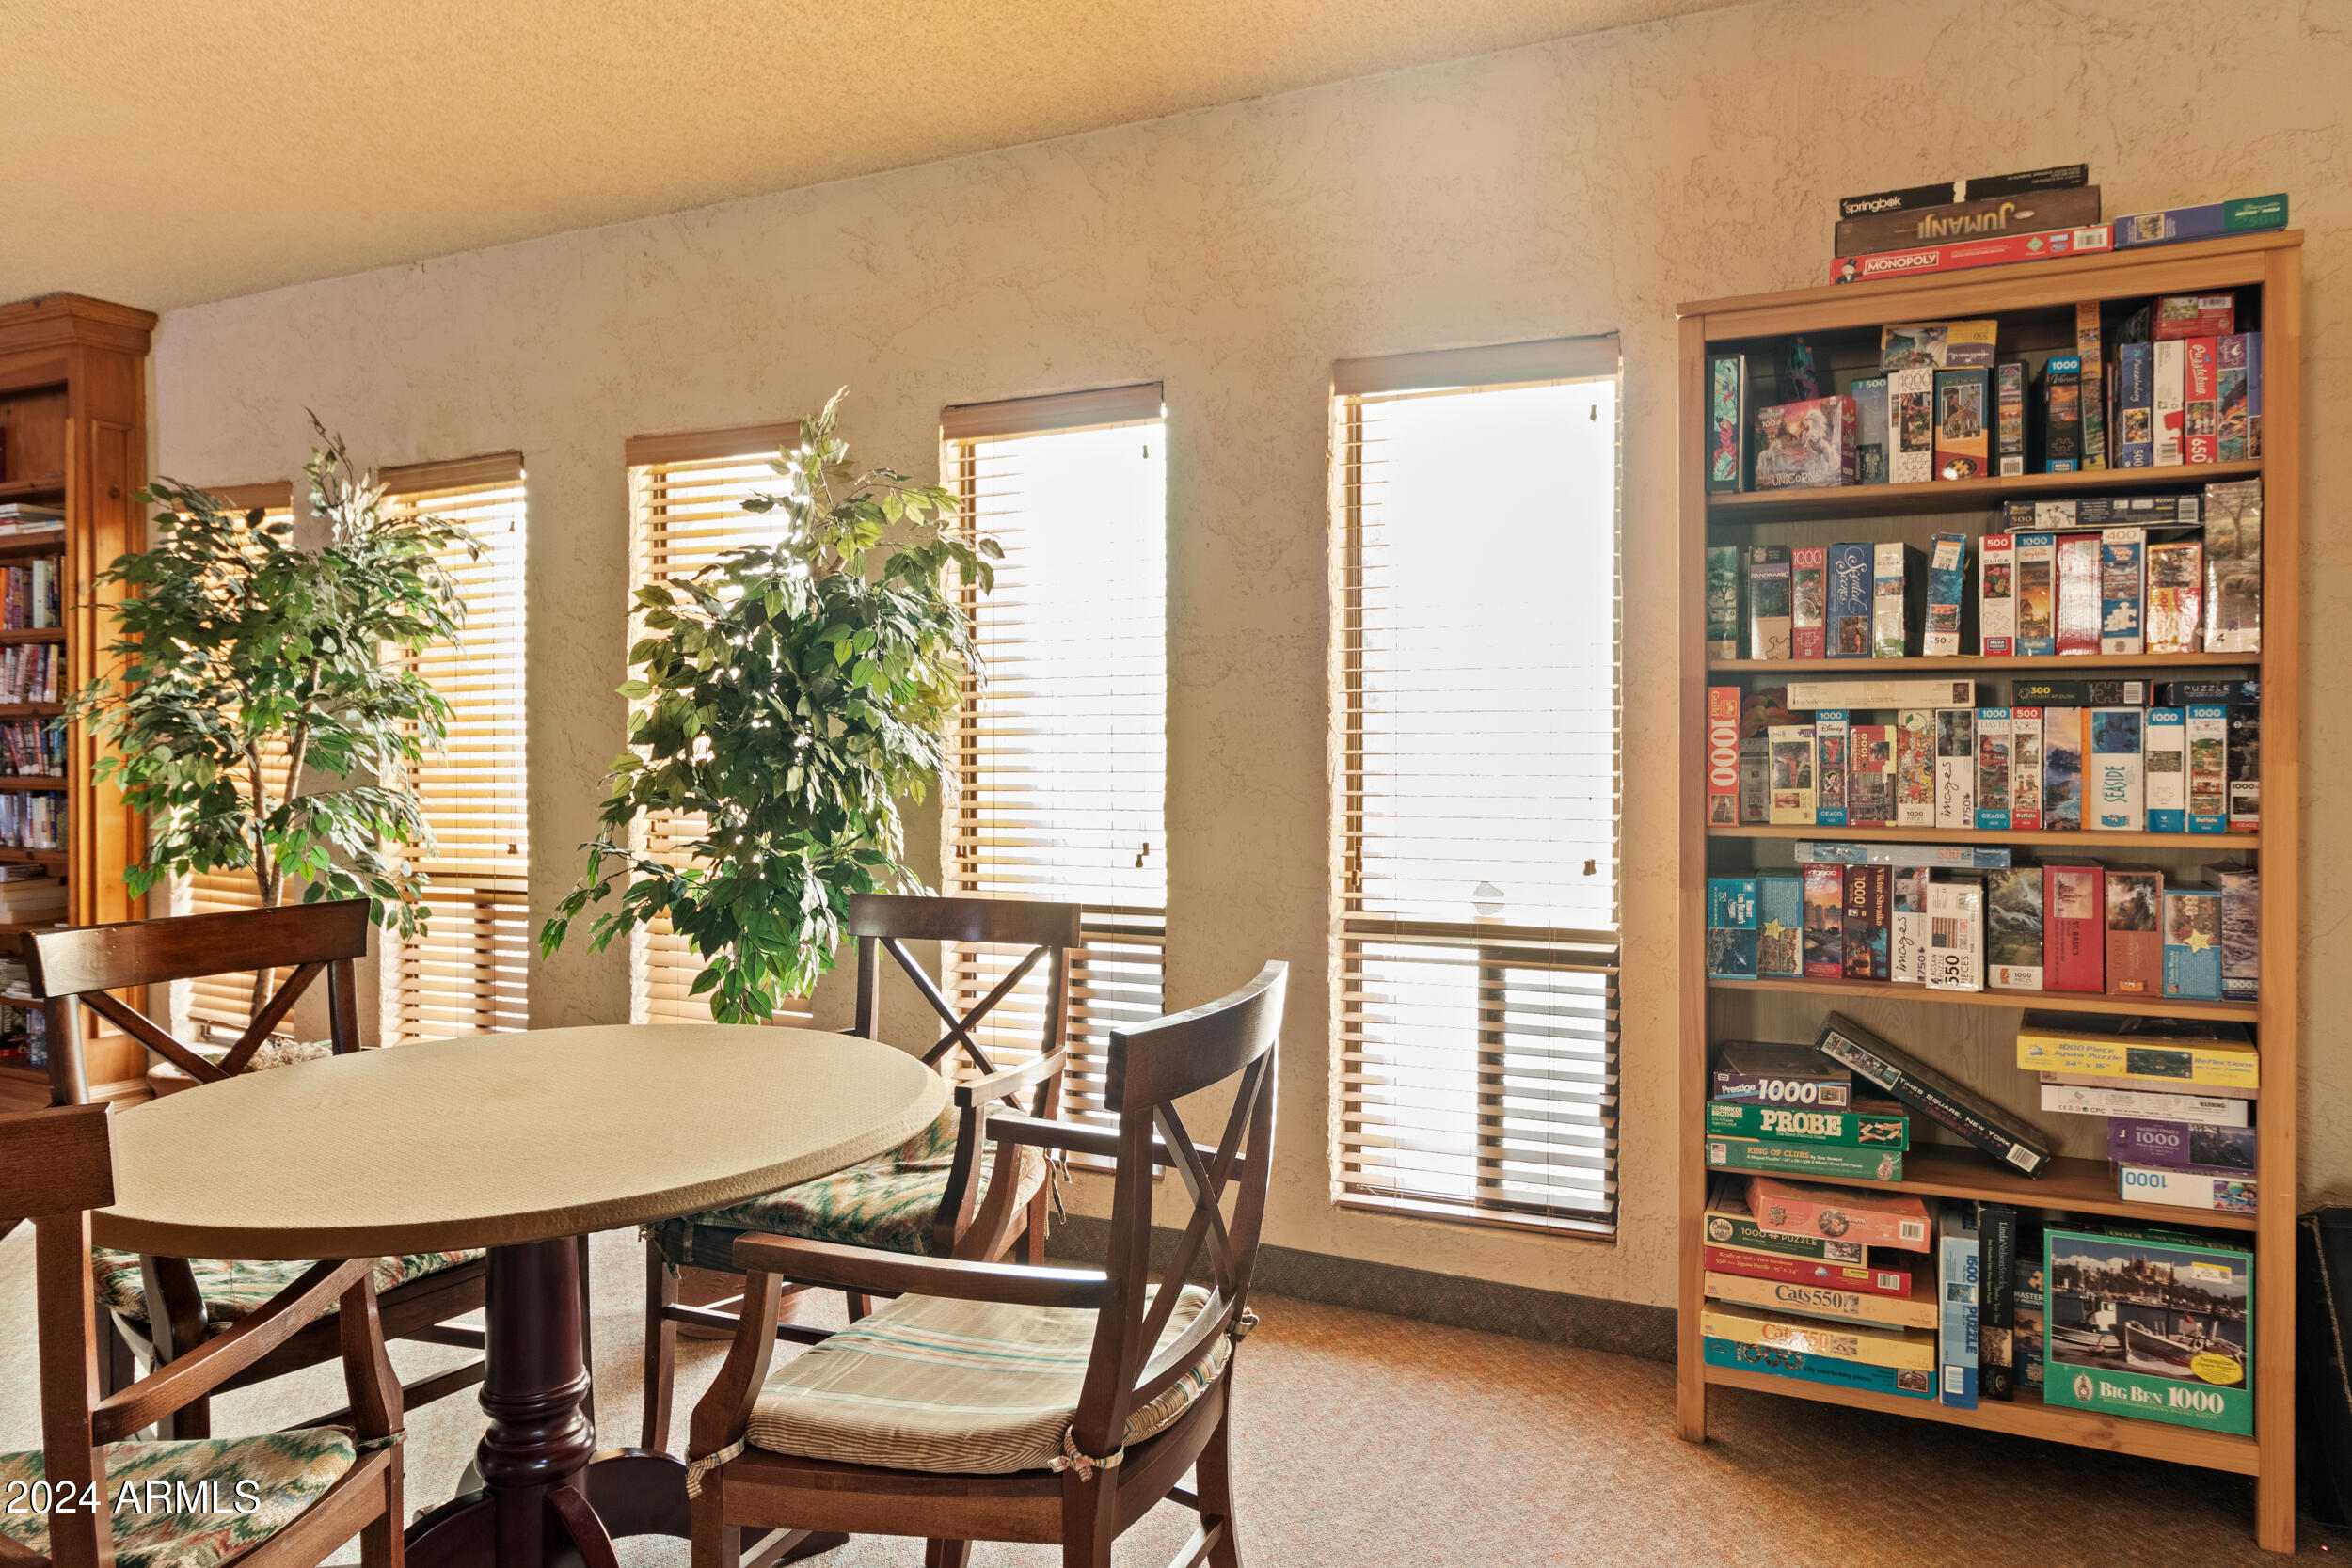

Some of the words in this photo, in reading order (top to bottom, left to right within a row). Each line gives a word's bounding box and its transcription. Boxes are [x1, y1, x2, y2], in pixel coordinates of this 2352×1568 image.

[1867, 254, 1936, 272] MONOPOLY
[2052, 360, 2077, 371] 1000
[1900, 372, 1931, 388] 1000
[2134, 449, 2144, 466] 500
[2191, 438, 2207, 462] 650
[1987, 538, 2008, 547] 500
[2023, 536, 2048, 546] 1000
[2106, 531, 2136, 540] 400
[1794, 550, 1822, 564] 1000
[2184, 684, 2231, 692] PUZZLE
[1711, 690, 1720, 718] Guild
[2193, 708, 2221, 717] 1000
[1982, 709, 2007, 718] 1000
[2152, 713, 2178, 721] 1000
[1819, 723, 1844, 734] Disney
[1710, 719, 1737, 786] 1000
[1941, 761, 1960, 817] images
[2104, 766, 2127, 803] SEASIDE
[1875, 867, 1885, 894] Viktor
[1854, 877, 1866, 905] 1000
[1897, 916, 1914, 972] images
[1917, 955, 1926, 978] 750
[1722, 1084, 1756, 1094] Prestige
[1758, 1079, 1817, 1104] 1000
[1899, 1077, 1924, 1096] TIMES
[1926, 1093, 1963, 1119] SQUARE,
[1964, 1117, 1985, 1132] NEW
[1988, 1130, 2011, 1148] YORK
[1760, 1110, 1842, 1136] PROBE
[2136, 1132, 2180, 1147] 1000
[1747, 1147, 1768, 1156] KING
[1783, 1150, 1810, 1159] CLUBS
[2125, 1172, 2167, 1188] 1000
[1741, 1227, 1766, 1238] 1000
[1781, 1234, 1818, 1246] PUZZLE
[1775, 1285, 1812, 1305] Cats
[1812, 1292, 1843, 1308] 550
[1965, 1306, 1979, 1354] PUZZLE
[2168, 1387, 2225, 1415] 1000
